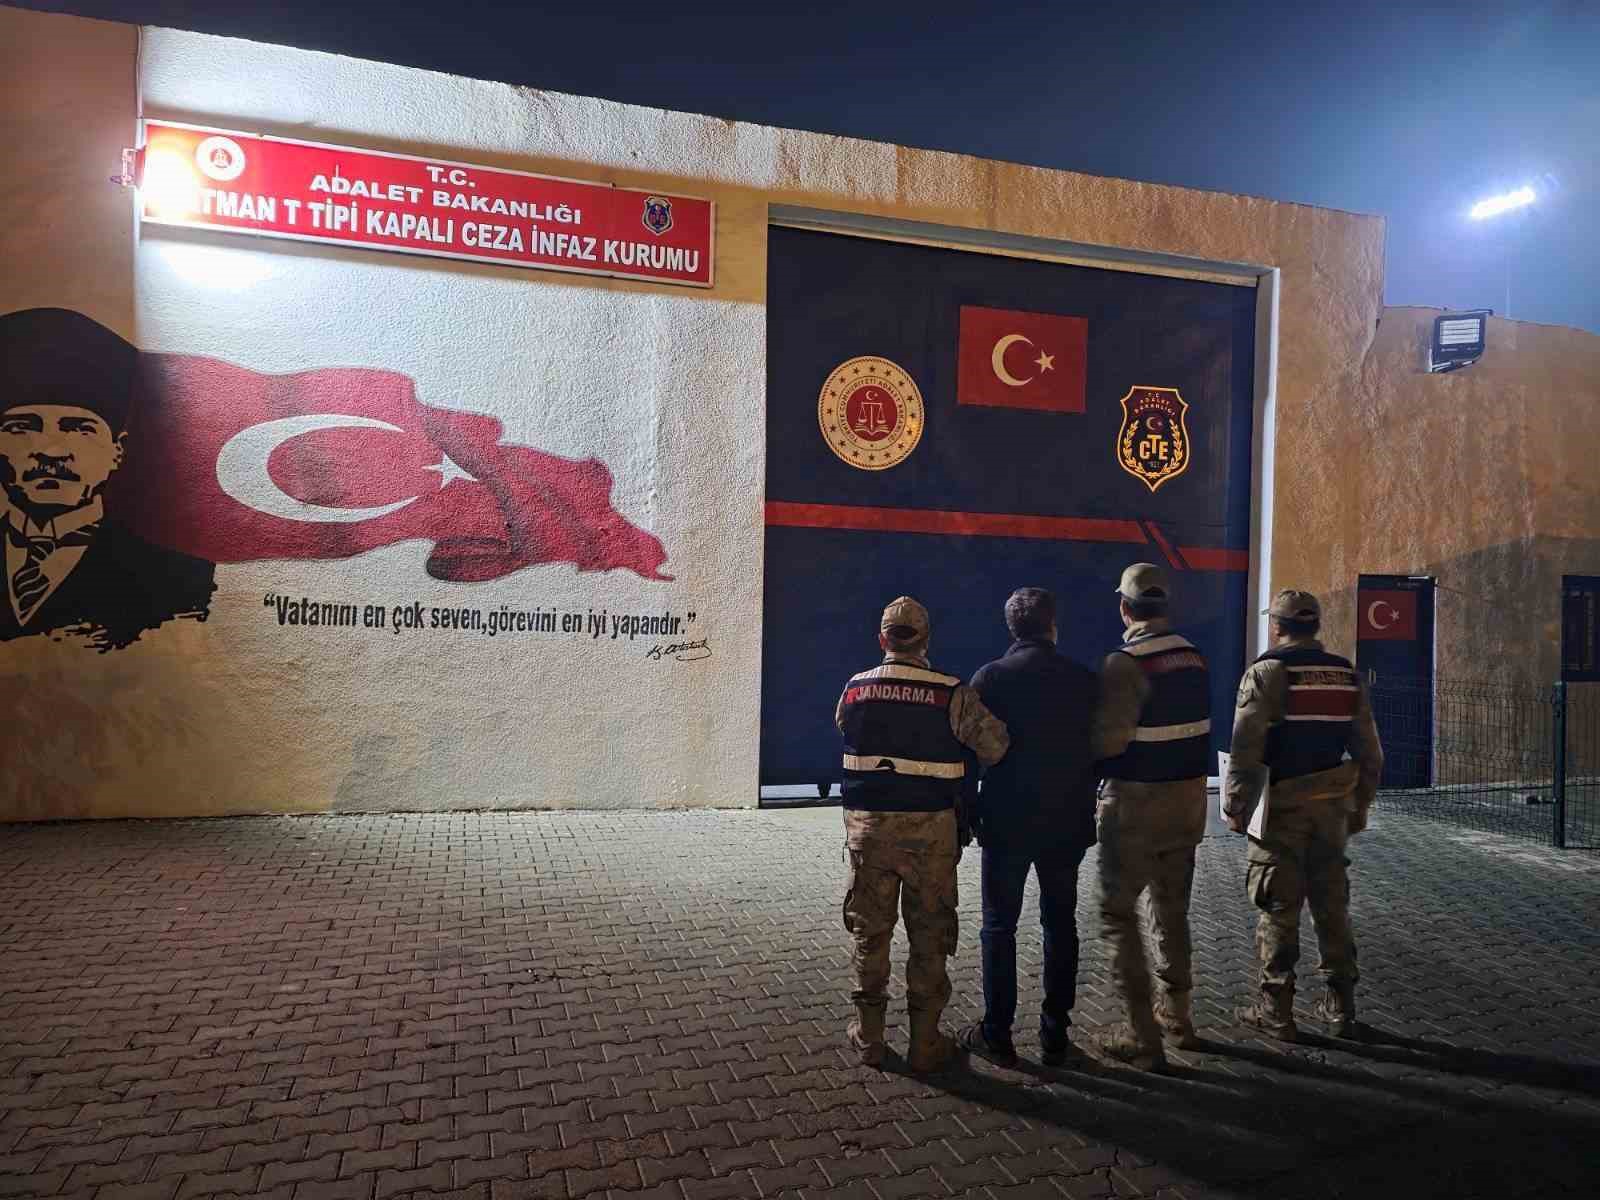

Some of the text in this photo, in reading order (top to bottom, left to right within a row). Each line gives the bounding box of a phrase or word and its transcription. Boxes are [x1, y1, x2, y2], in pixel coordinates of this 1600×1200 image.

[426, 166, 475, 188] T.C.
[310, 174, 581, 225] ADALET BAKANLIĞI
[200, 188, 699, 273] TMAN T TİPİ KAPALI CEZA İNFAZ KURUMU
[363, 604, 386, 628] en
[392, 601, 426, 635] çok
[562, 612, 583, 633] en
[588, 609, 607, 639] iyi
[856, 684, 936, 704] JANDARMA
